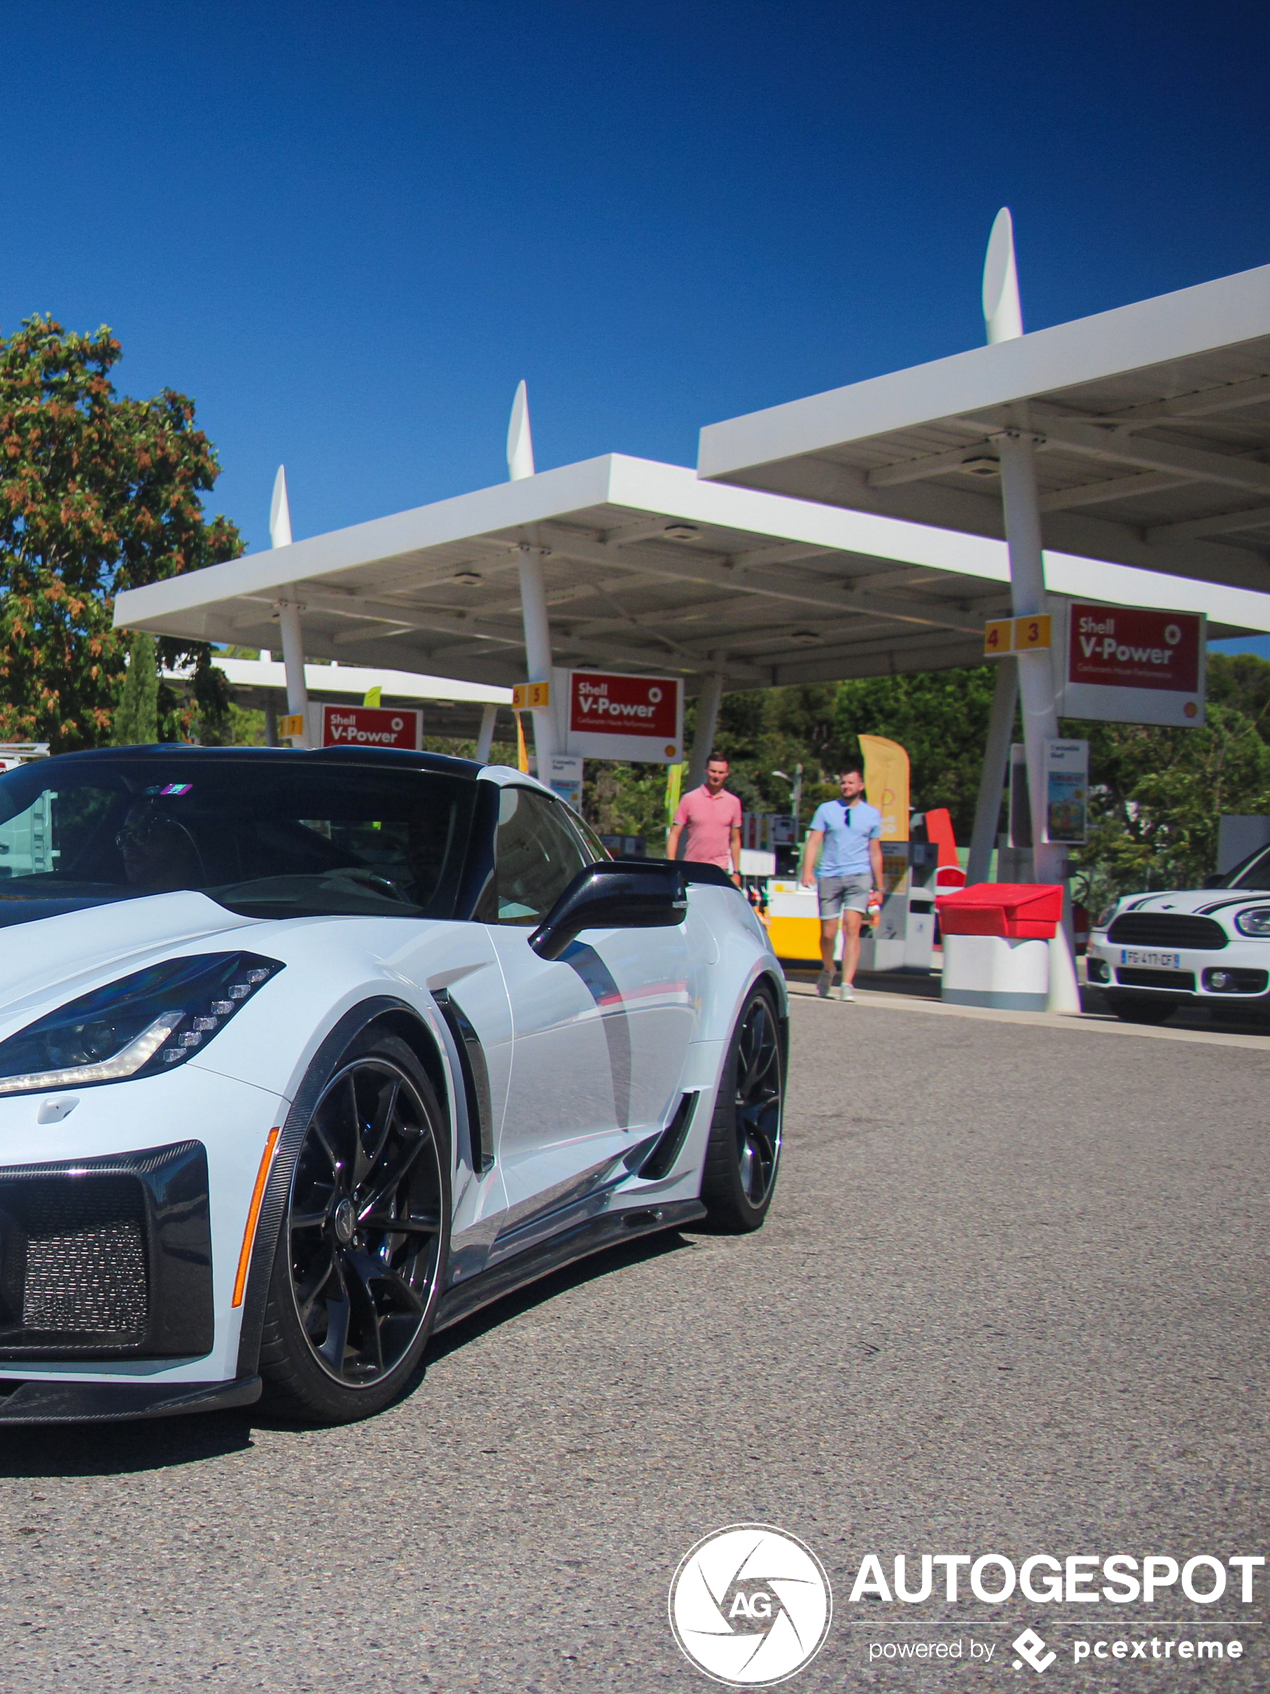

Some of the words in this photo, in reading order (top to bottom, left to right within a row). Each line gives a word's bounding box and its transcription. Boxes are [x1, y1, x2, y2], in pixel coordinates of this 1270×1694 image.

[1027, 622, 1039, 641] 3
[1079, 617, 1115, 635] Shell
[986, 629, 999, 647] 4
[1079, 636, 1173, 664] V-Power
[534, 687, 541, 702] 5
[578, 682, 608, 696] Shell
[578, 696, 656, 718] V-Power
[330, 714, 356, 726] Shell
[330, 726, 398, 743] V-Power
